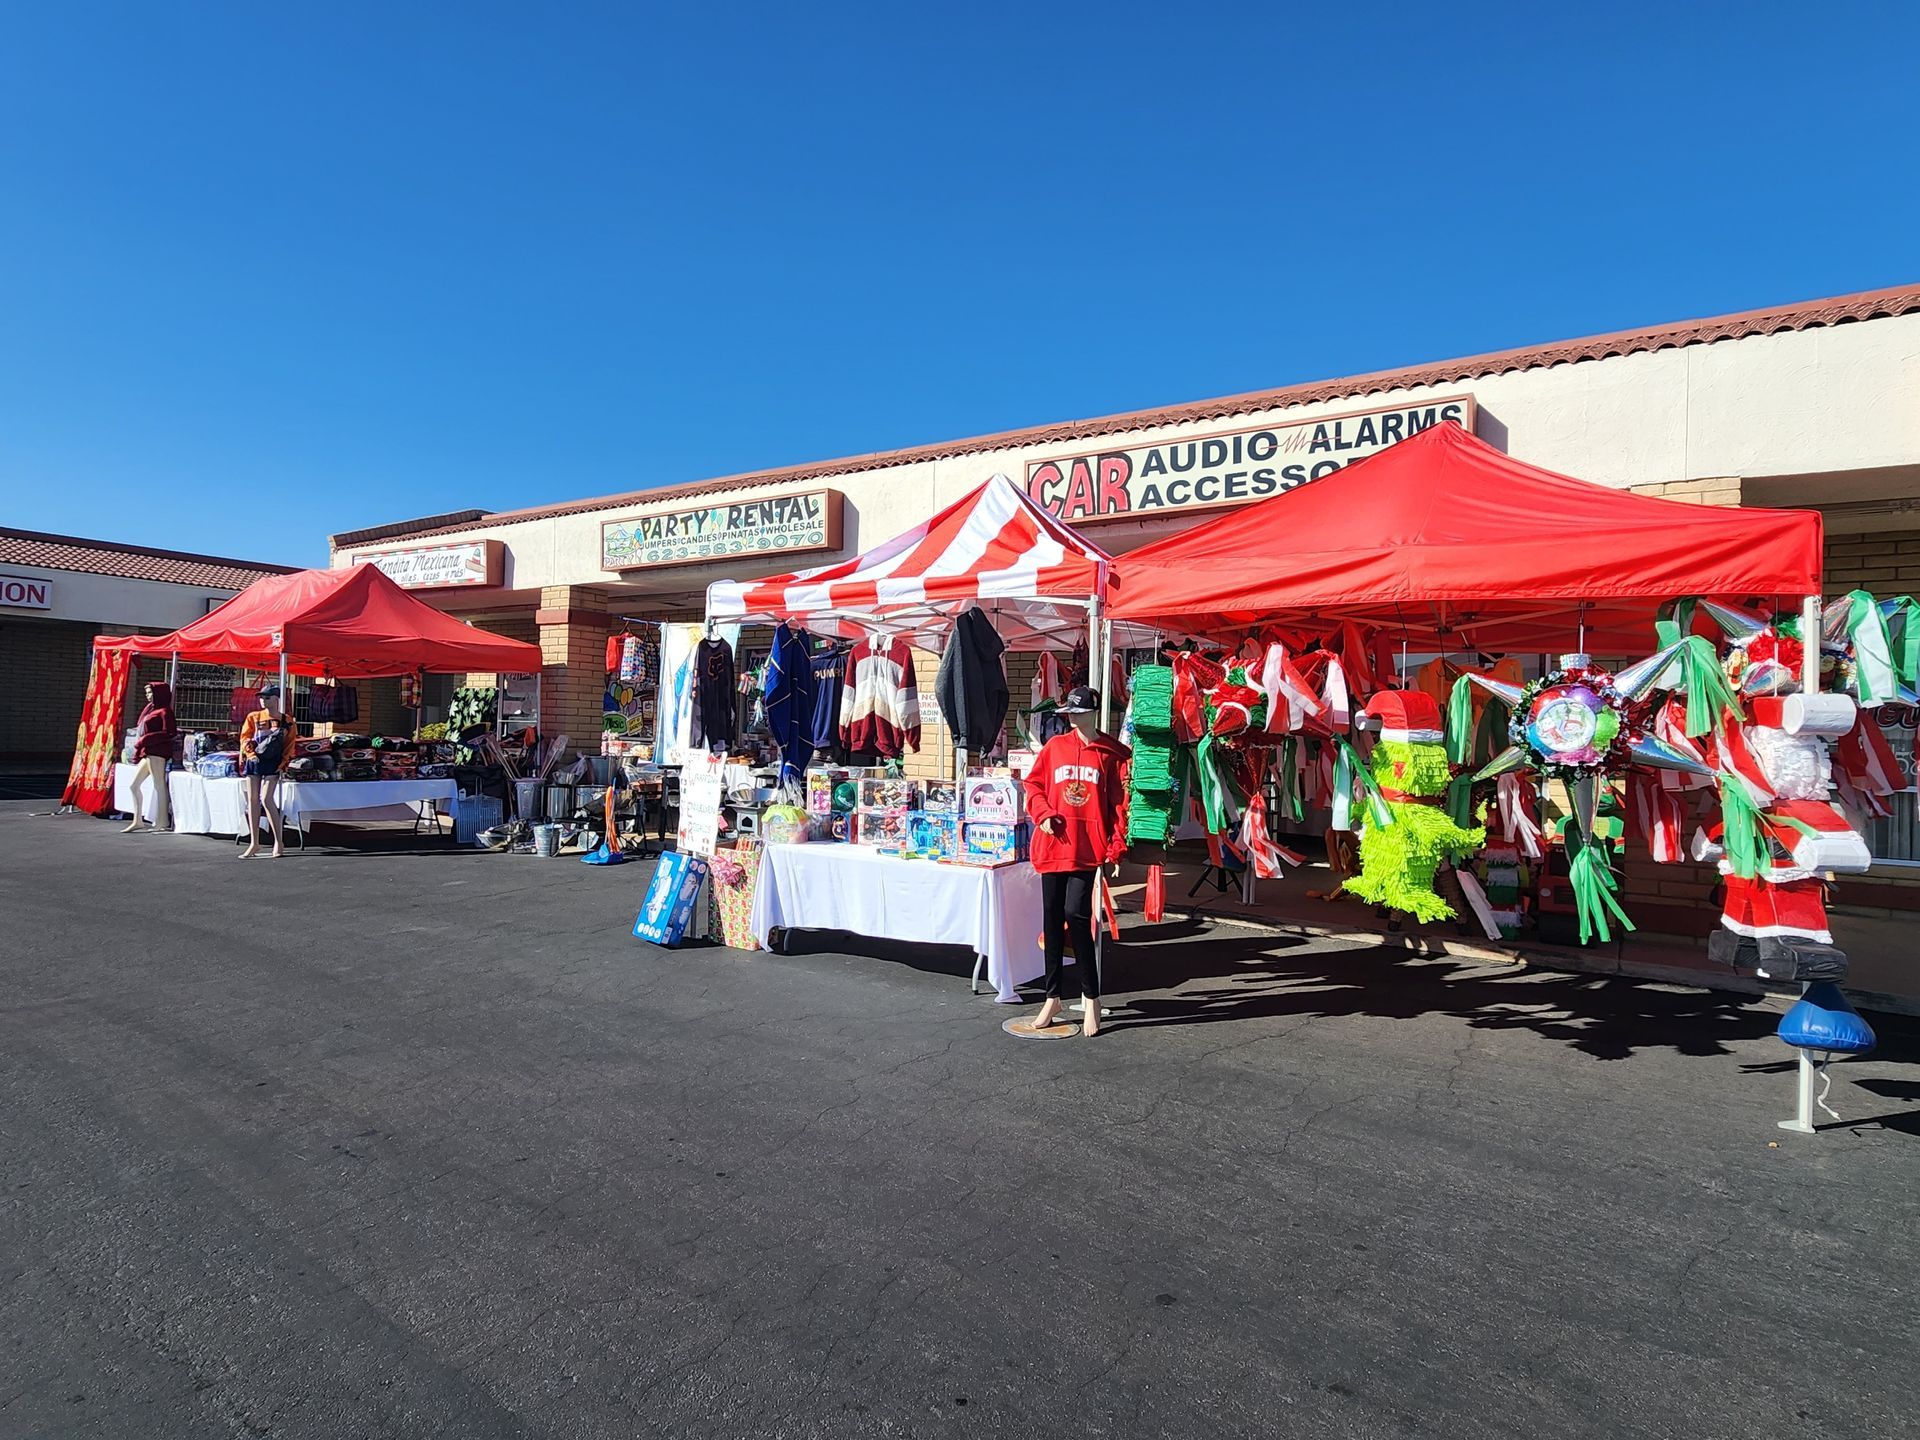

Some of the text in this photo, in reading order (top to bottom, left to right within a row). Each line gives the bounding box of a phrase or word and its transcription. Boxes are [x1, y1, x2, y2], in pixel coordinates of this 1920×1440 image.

[1140, 432, 1279, 477] AUDIO
[1029, 451, 1134, 519] CAR
[1138, 456, 1373, 510] ACCESSO
[640, 495, 820, 541] PARTY RENTAL
[681, 533, 717, 546] CANDIES
[766, 519, 824, 535] WHOLESALE
[412, 553, 461, 572] Mexicana
[646, 531, 824, 562] 623-583-9070
[1055, 765, 1100, 784] MEXICO
